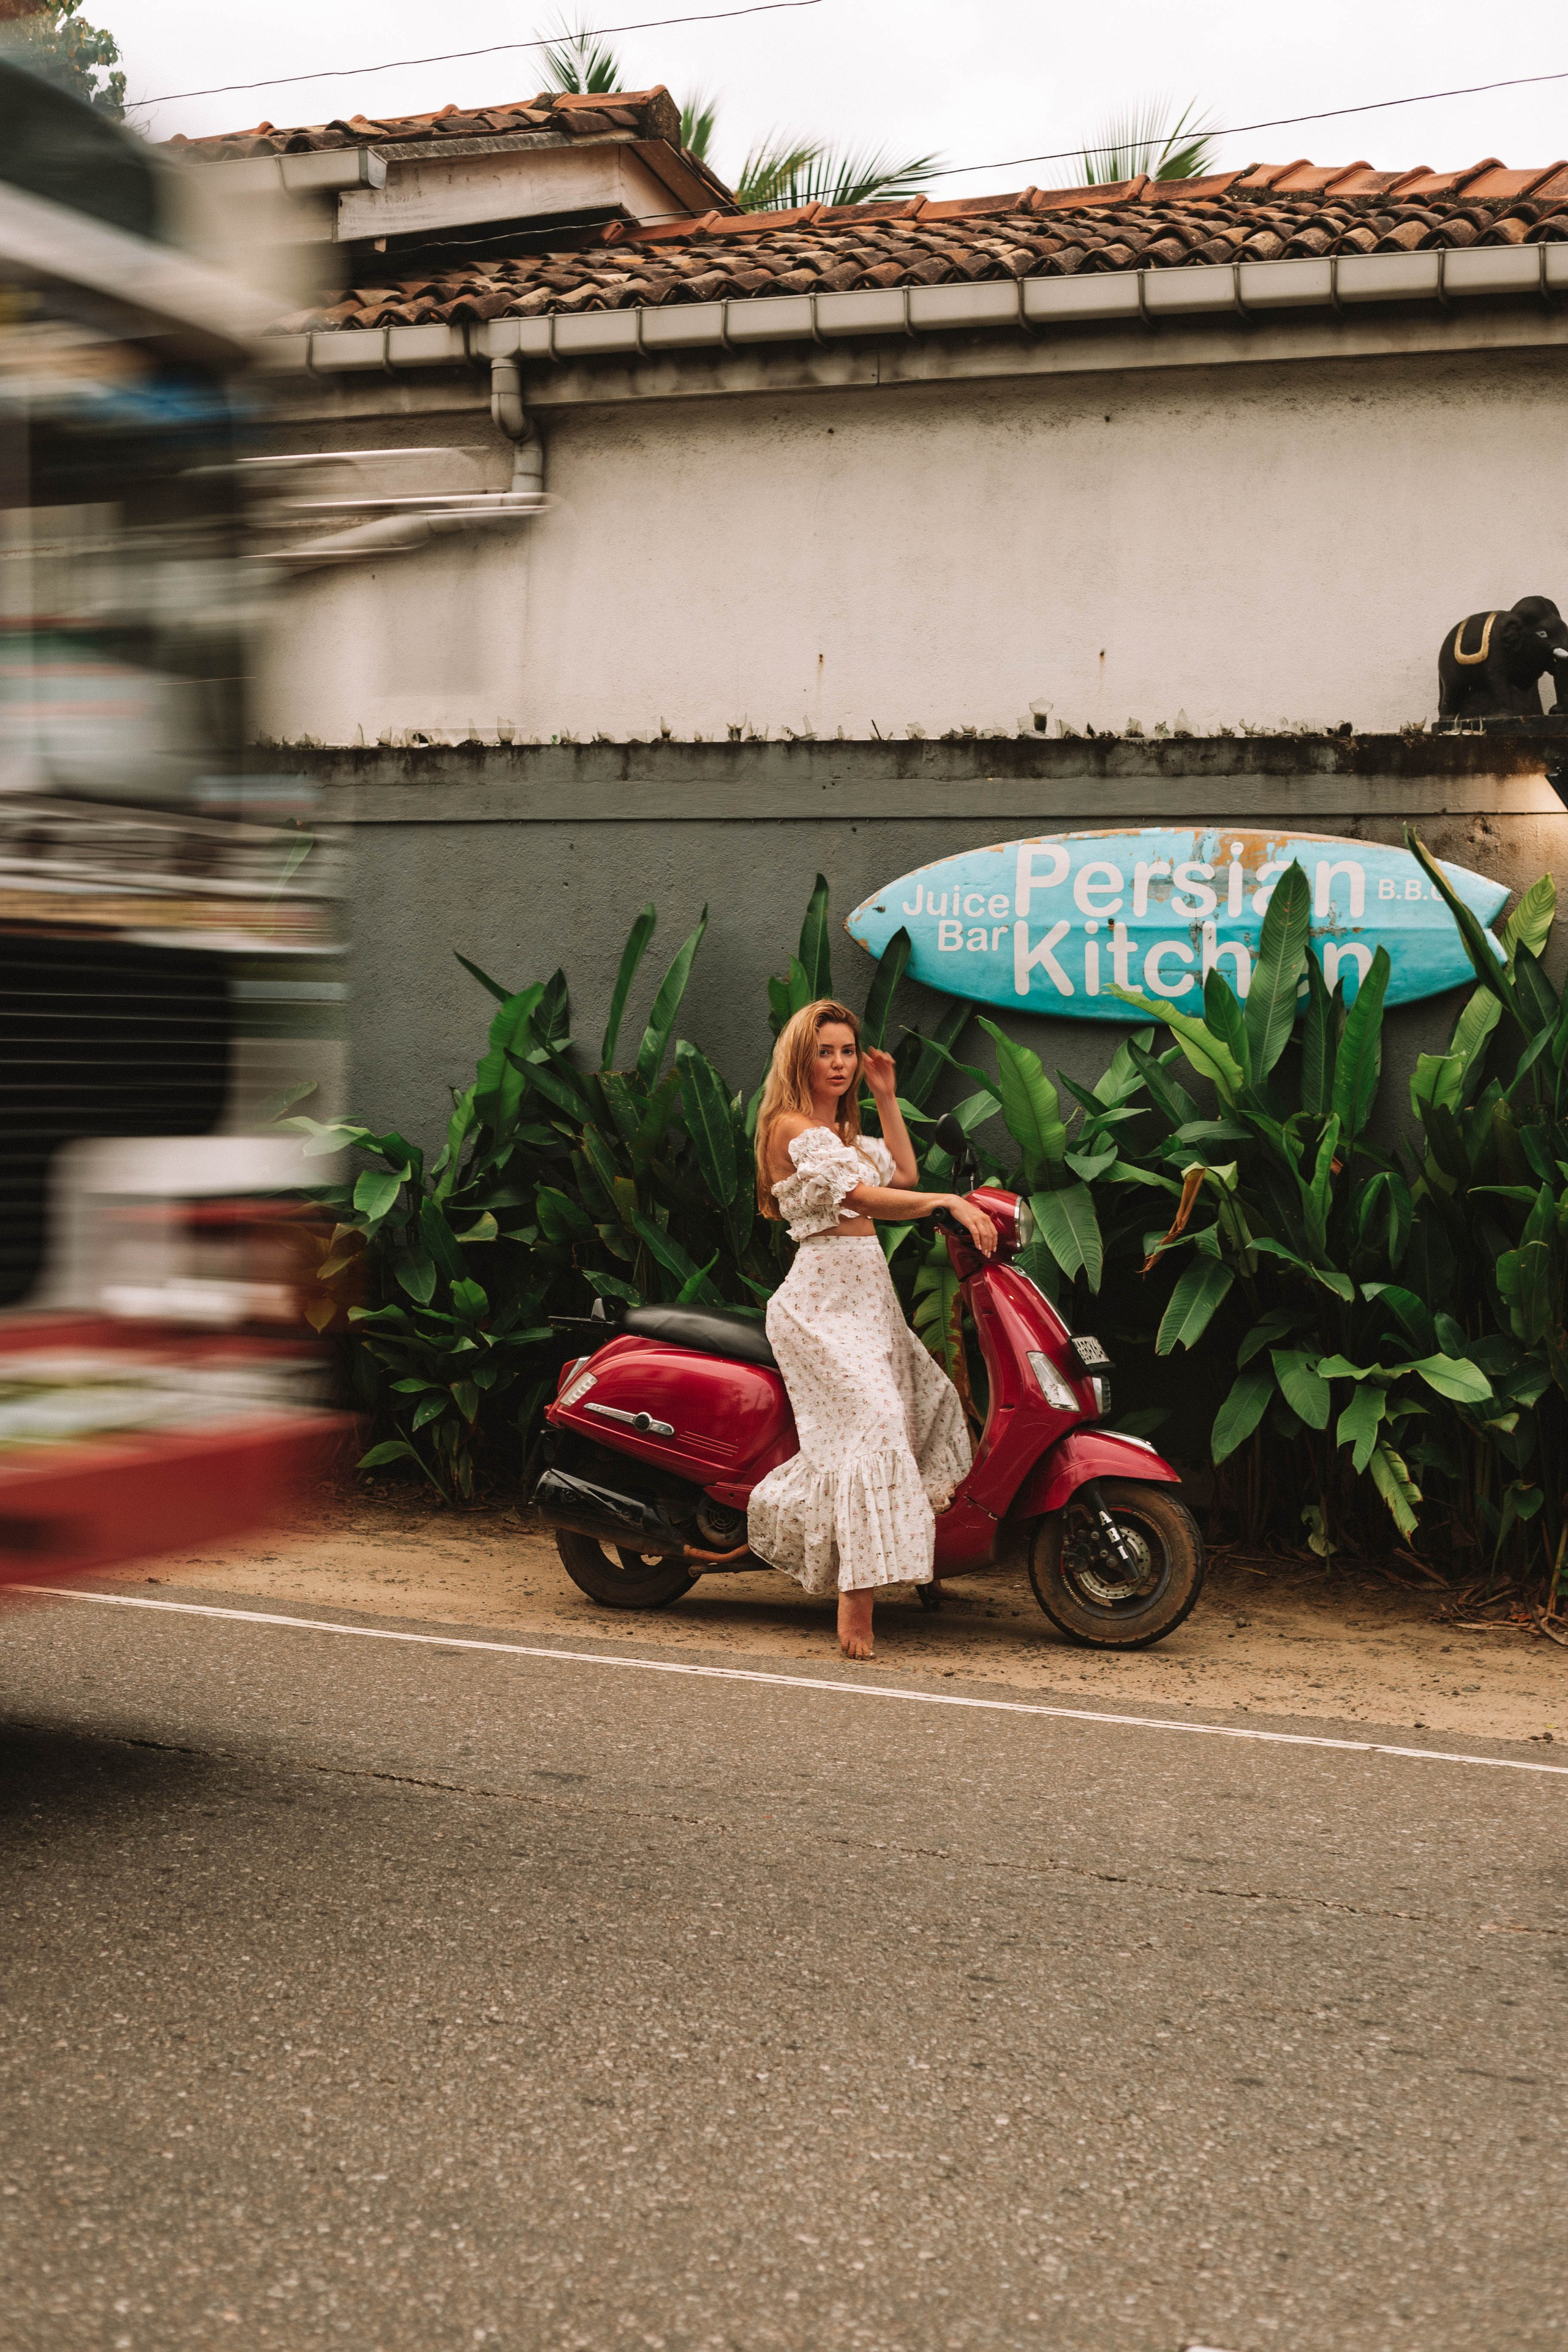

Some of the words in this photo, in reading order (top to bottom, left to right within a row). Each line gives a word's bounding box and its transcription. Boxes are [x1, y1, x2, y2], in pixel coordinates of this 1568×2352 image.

[902, 884, 1010, 919] Juice
[938, 919, 1009, 952] Bar
[1014, 919, 1374, 998] Kitchn
[1098, 1510, 1129, 1560] ABI
